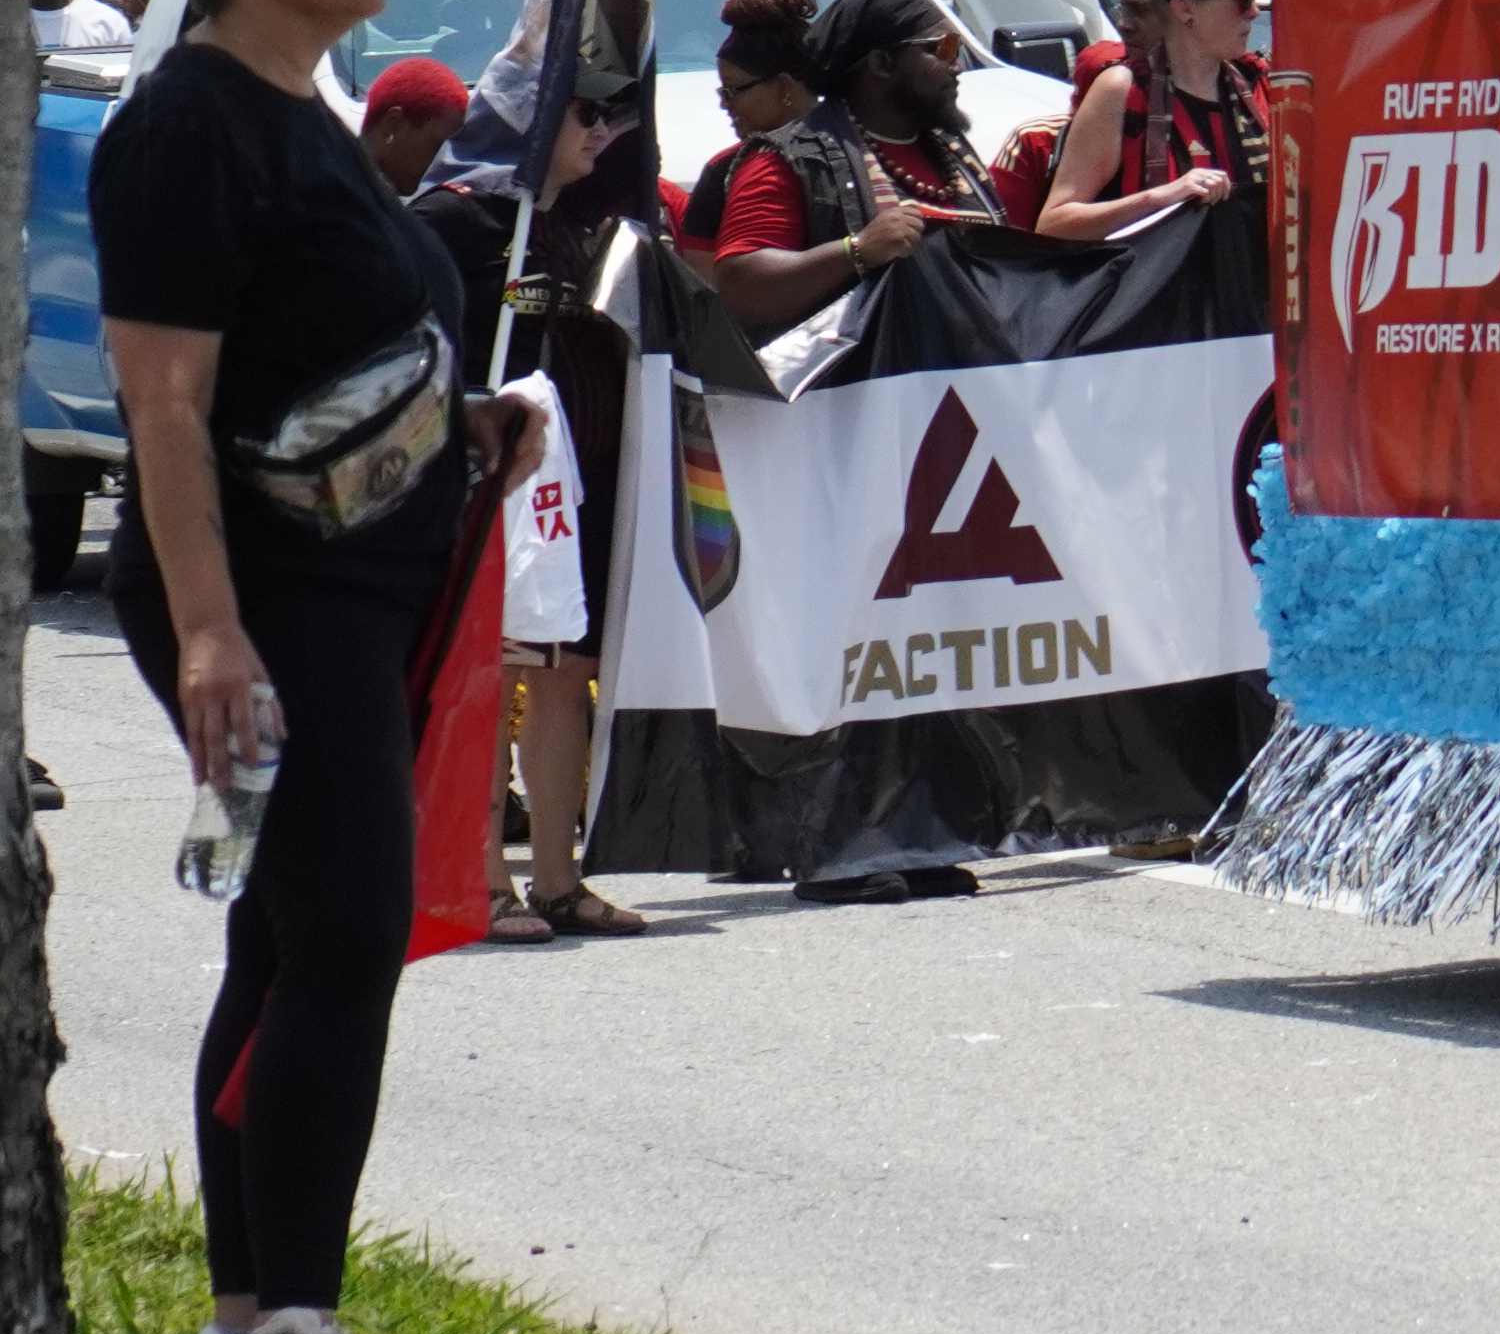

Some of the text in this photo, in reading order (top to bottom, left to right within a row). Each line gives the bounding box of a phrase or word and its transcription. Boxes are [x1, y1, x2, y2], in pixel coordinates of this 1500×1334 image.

[1383, 80, 1453, 120] RUFF
[1376, 322, 1467, 354] RESTORE
[1470, 322, 1483, 351] X
[839, 614, 1113, 710] FACTION
